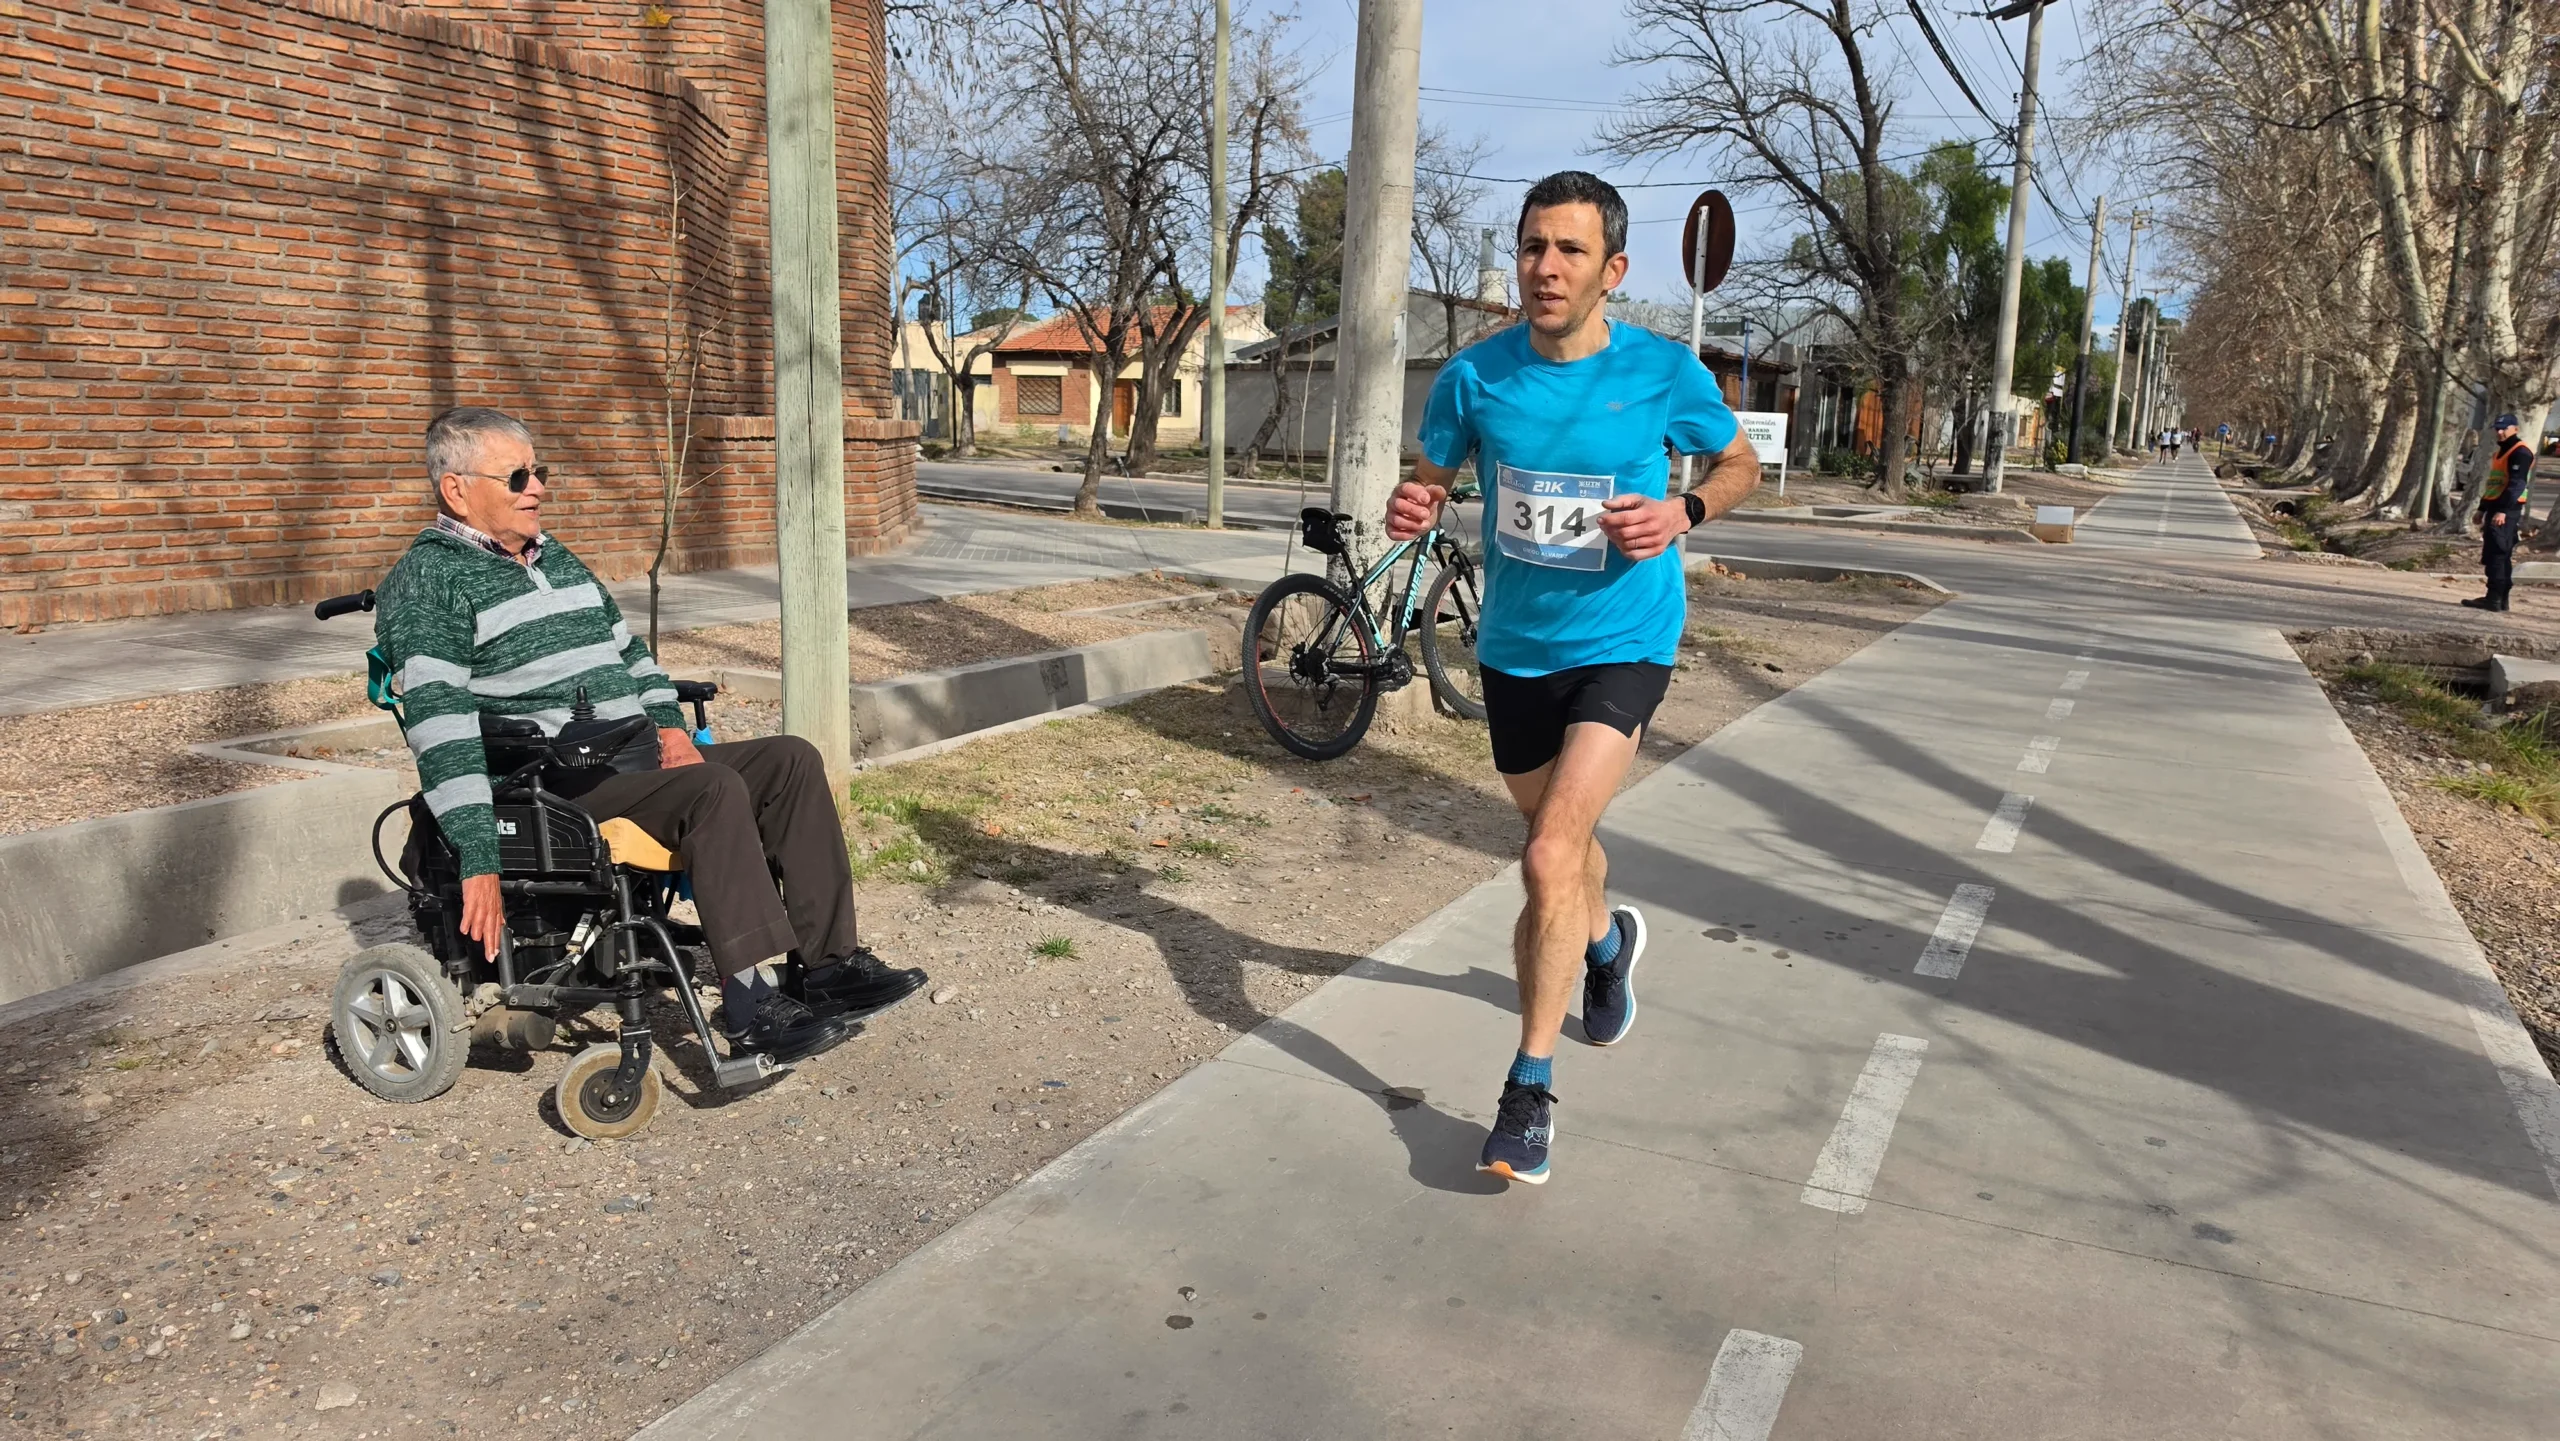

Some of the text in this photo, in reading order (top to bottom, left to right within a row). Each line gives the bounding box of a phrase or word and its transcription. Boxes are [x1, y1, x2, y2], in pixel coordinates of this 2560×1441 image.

[1532, 481, 1566, 493] 21K
[1513, 501, 1586, 537] 314
[1402, 554, 1427, 628] TOPMEGA
